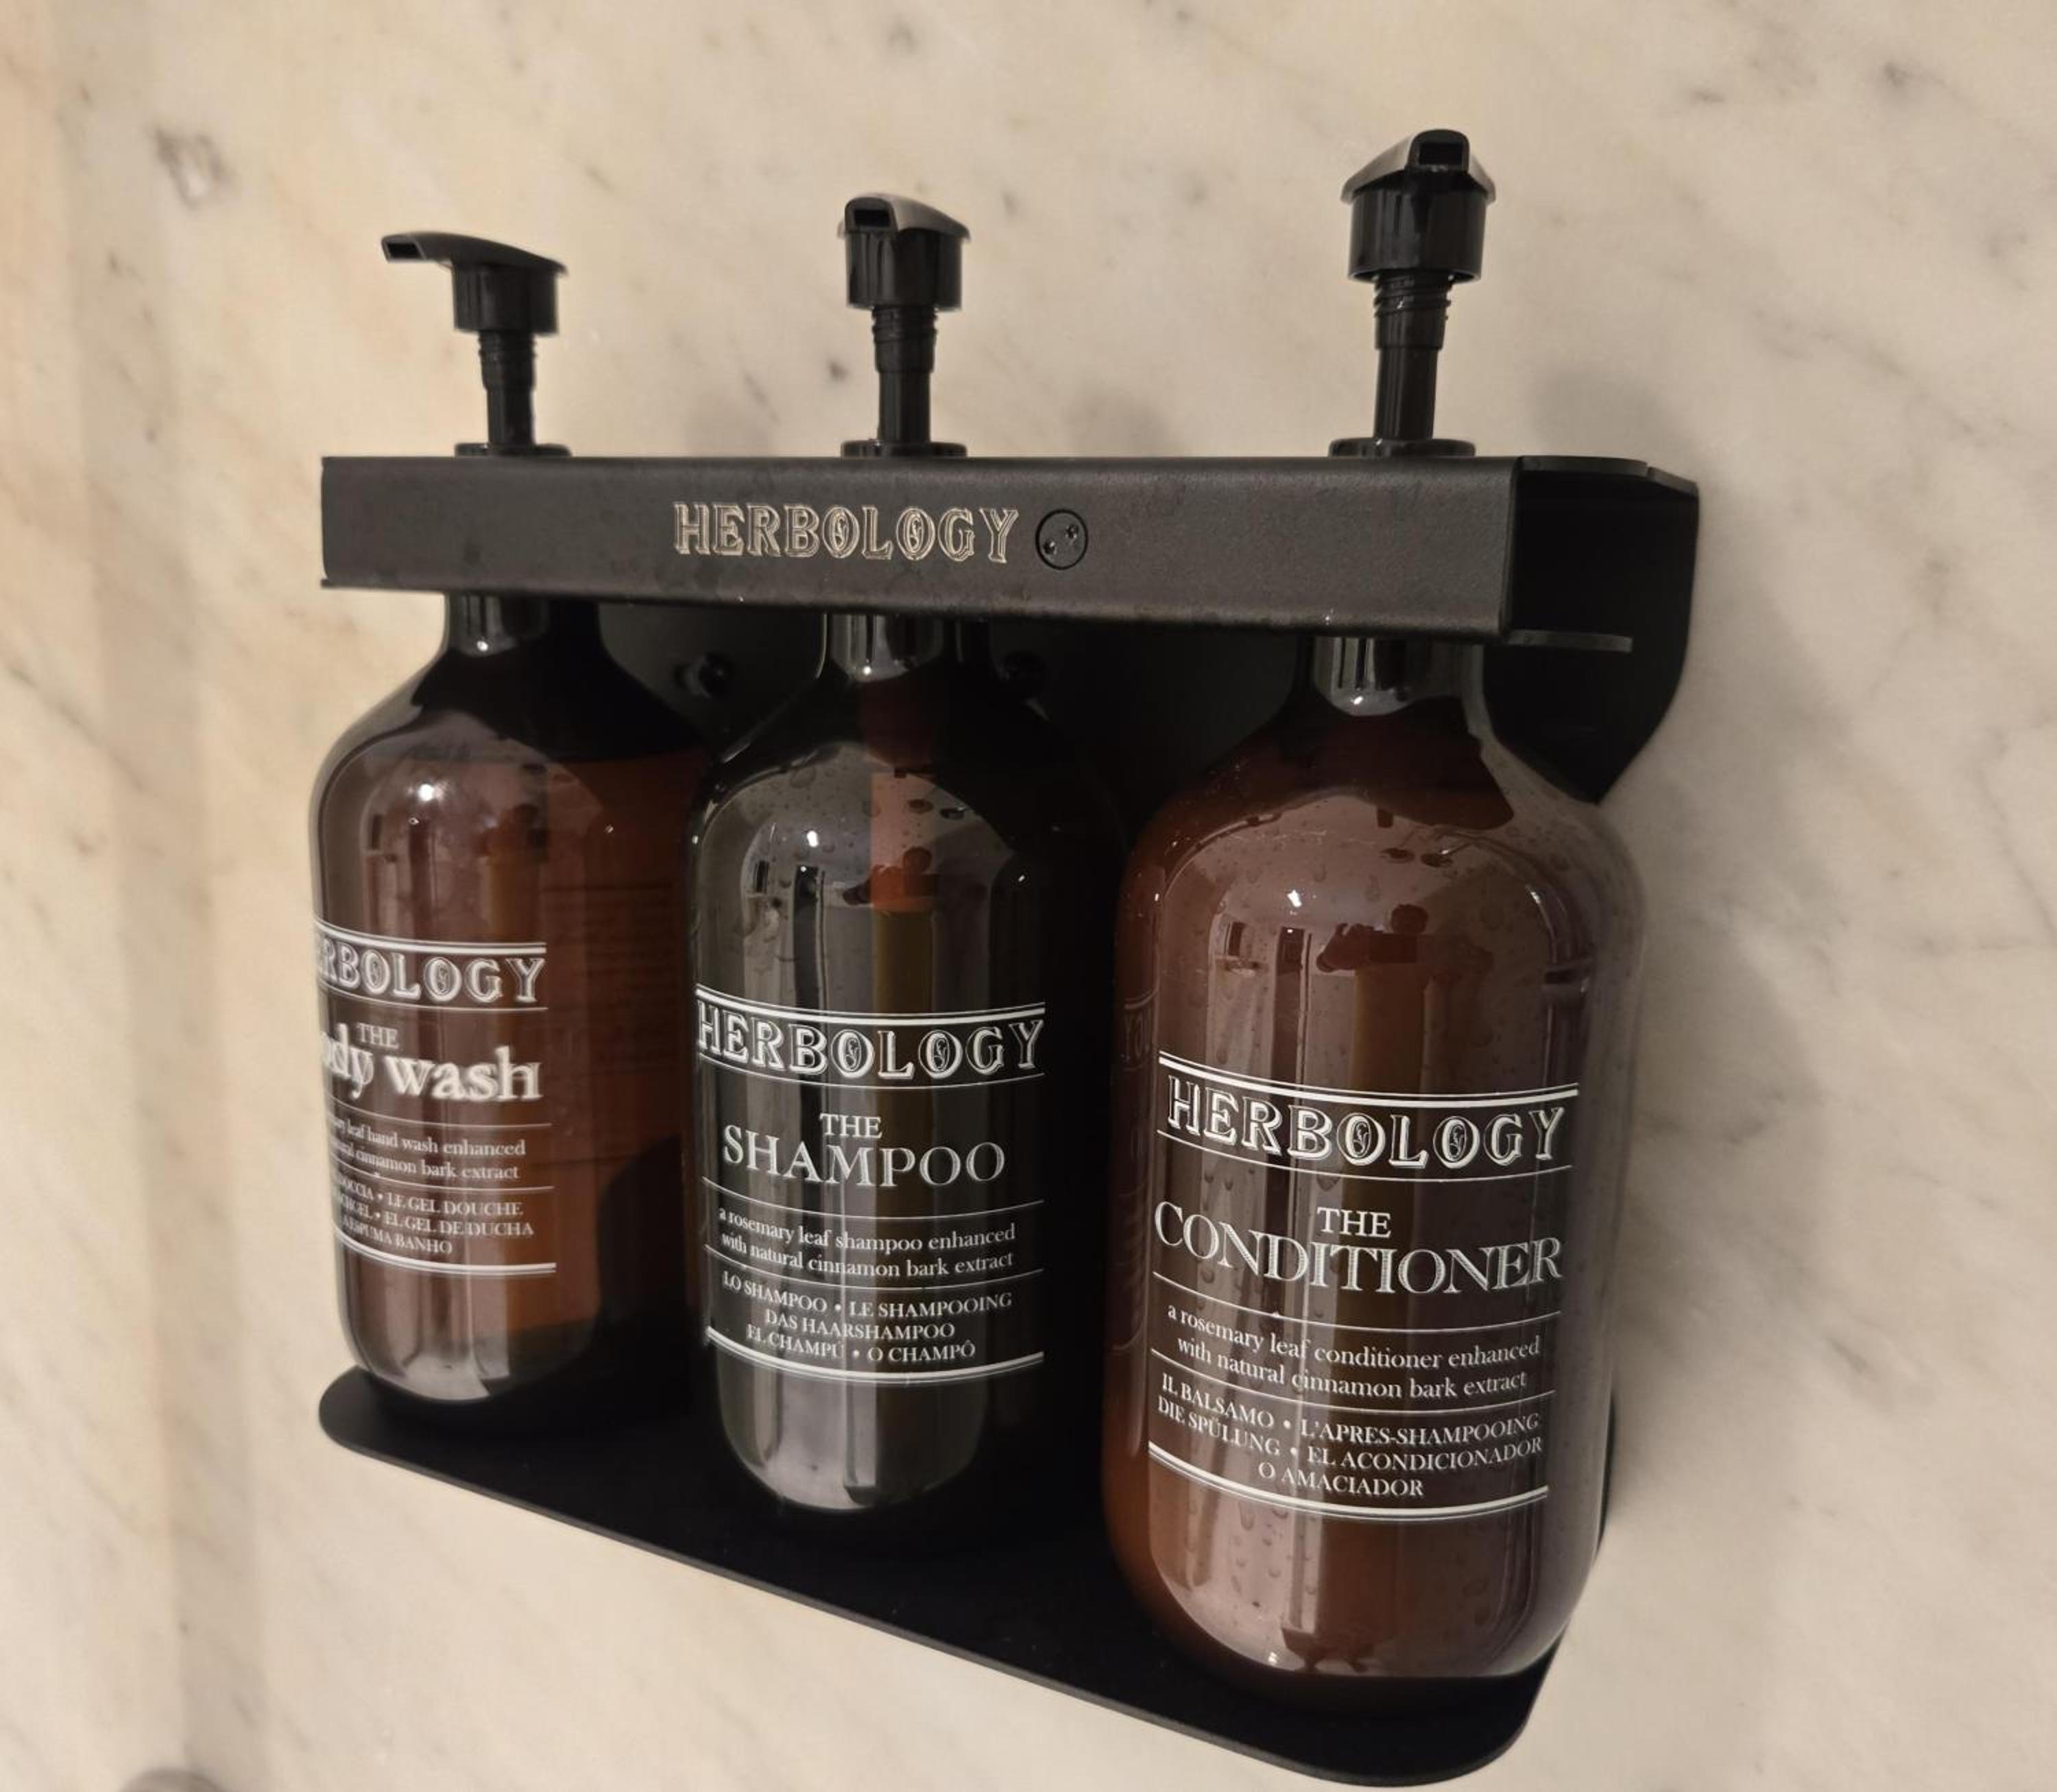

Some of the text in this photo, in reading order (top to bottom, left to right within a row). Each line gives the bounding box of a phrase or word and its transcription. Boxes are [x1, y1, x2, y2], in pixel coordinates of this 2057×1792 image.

[672, 501, 1020, 564] HERBOLOGY
[319, 937, 546, 1004] RBOLOGY
[355, 1022, 400, 1049] THE
[696, 1000, 1044, 1080] HERBOLOGY
[383, 1045, 543, 1102] wash
[367, 1125, 398, 1148] hand
[401, 1136, 439, 1155] wash
[442, 1139, 527, 1156] enhanced
[819, 1112, 884, 1139] THE
[1168, 1075, 1564, 1169] HERBOLOGY
[421, 1159, 457, 1178] bark
[461, 1165, 520, 1180] extract
[722, 1124, 1006, 1188] SHAMPOO
[384, 1211, 403, 1227] EL
[405, 1216, 437, 1233] GEL
[440, 1220, 465, 1235] DE
[466, 1222, 535, 1236] DUCHA
[387, 1191, 406, 1209] LE
[408, 1196, 440, 1213] GEL
[444, 1201, 524, 1216] DOUCHE
[1316, 1207, 1392, 1238] THE
[394, 1233, 453, 1254] BANHO
[719, 1207, 1016, 1256] a rosemary leaf shampoo enhanced
[722, 1232, 1013, 1277] with natural cinnamon bark extract
[1154, 1201, 1563, 1294] CONDITIONER
[722, 1270, 1013, 1318] LO SHAMPOO LE SHAMPOOING
[746, 1324, 767, 1343] EL
[867, 1347, 884, 1362] O
[889, 1339, 976, 1363] CHAMPÔ
[765, 1309, 955, 1340] DAS HAARSHAMPOO
[1168, 1305, 1541, 1369] a rosemary leaf conditioner enhanced
[1177, 1337, 1528, 1399] with natural cinnamon bark extract
[1162, 1372, 1178, 1396] IL
[1180, 1382, 1275, 1427] BALSAMO
[1157, 1395, 1543, 1471] DIE SPÜLUNG EL ACONDICIONADOR
[1258, 1462, 1425, 1496] O AMACIADOR
